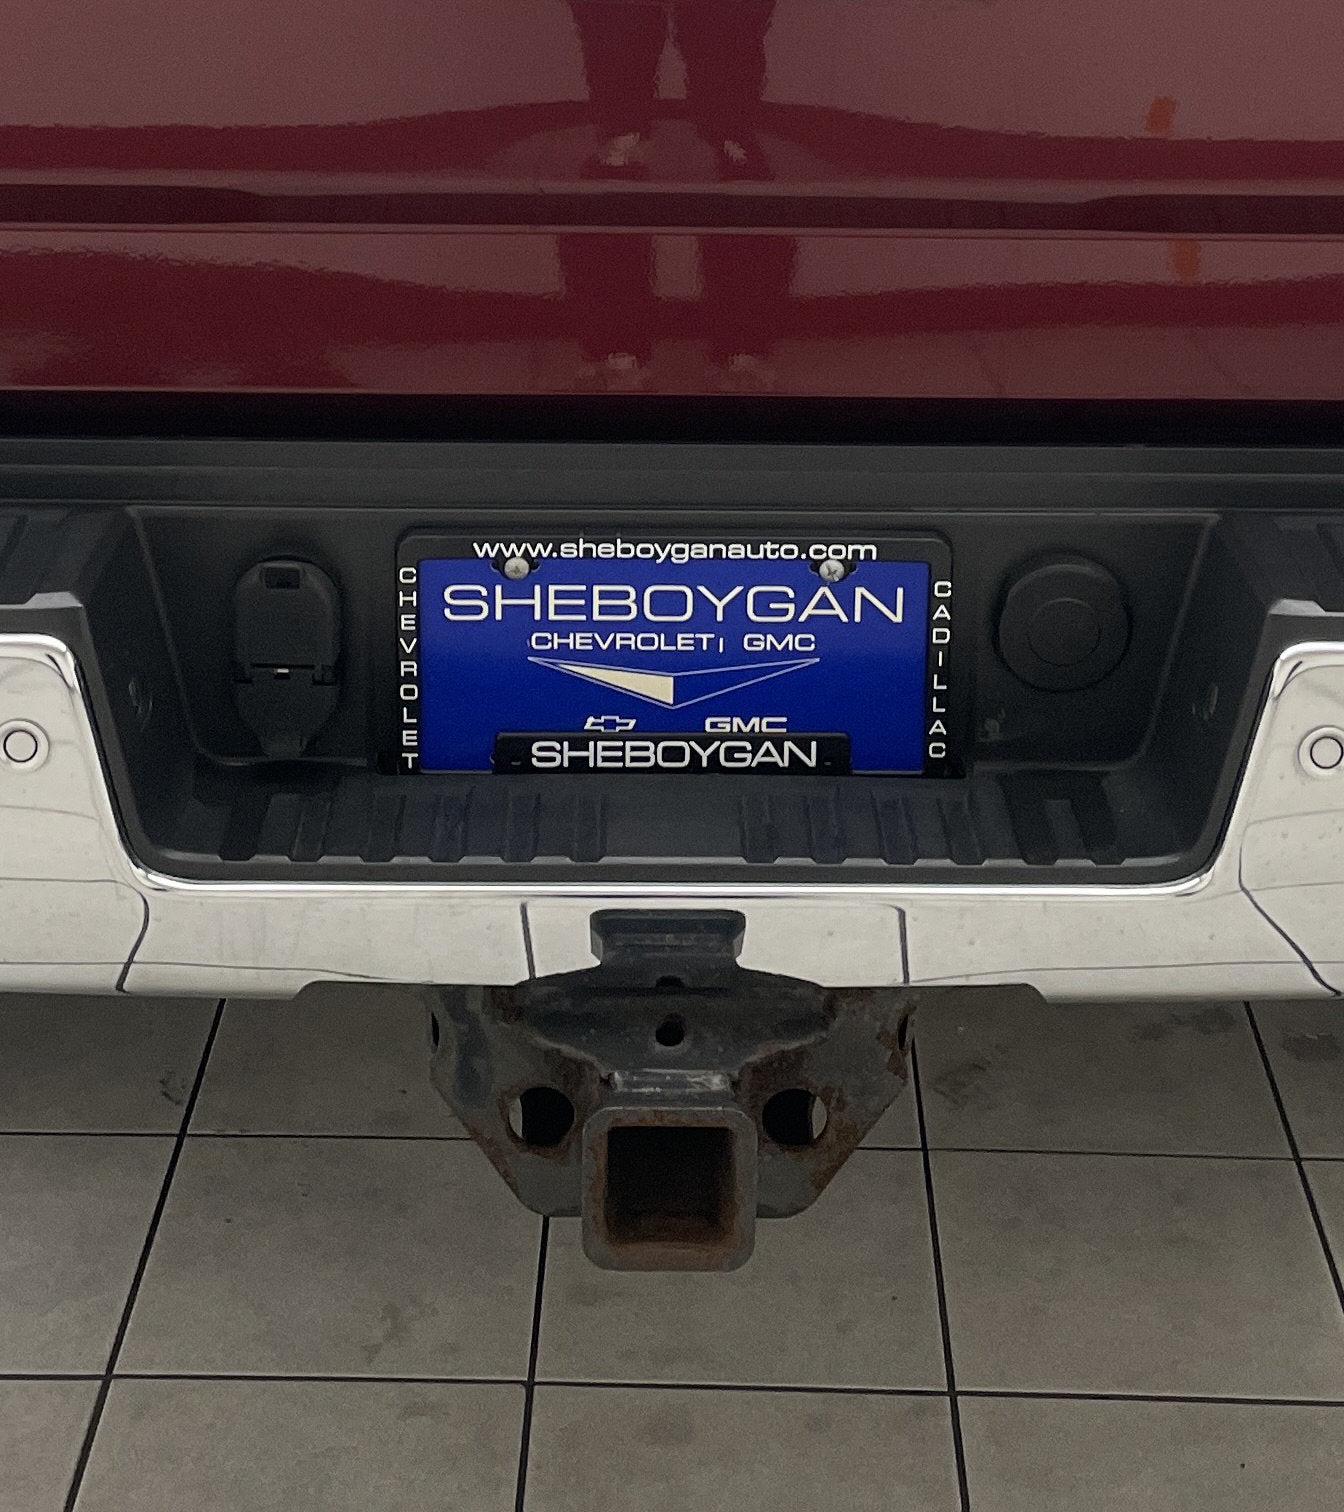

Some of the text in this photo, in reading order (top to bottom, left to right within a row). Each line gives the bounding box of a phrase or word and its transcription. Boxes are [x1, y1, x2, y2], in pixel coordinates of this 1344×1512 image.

[472, 539, 877, 562] www.sheboyganauto.com
[442, 584, 904, 624] SHEBOYGAN
[531, 633, 816, 652] CHEVROLET GMC
[398, 567, 419, 769] CHEVROLET
[928, 581, 953, 759] CADILLAC
[704, 716, 788, 734] GMC
[531, 740, 817, 767] SHEBOYGAN
